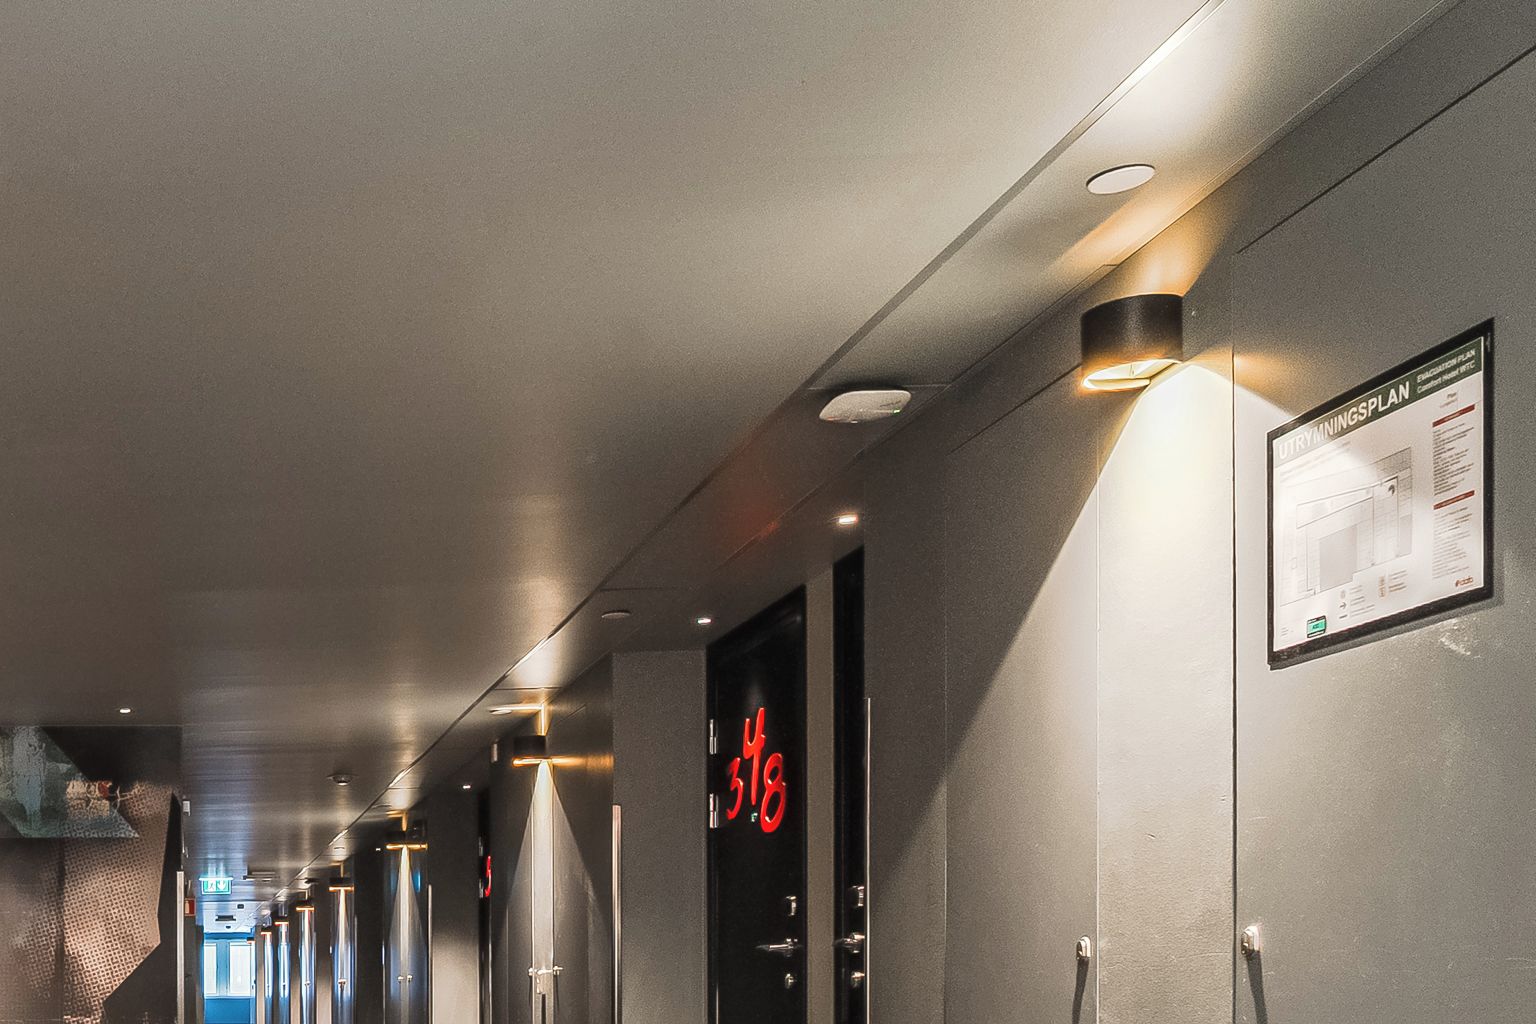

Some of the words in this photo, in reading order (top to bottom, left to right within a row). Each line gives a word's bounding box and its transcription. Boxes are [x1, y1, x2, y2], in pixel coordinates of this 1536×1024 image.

[1457, 348, 1476, 363] PLAN
[1278, 380, 1410, 460] UTRYMNINGSPLAN
[727, 706, 787, 833] 348
